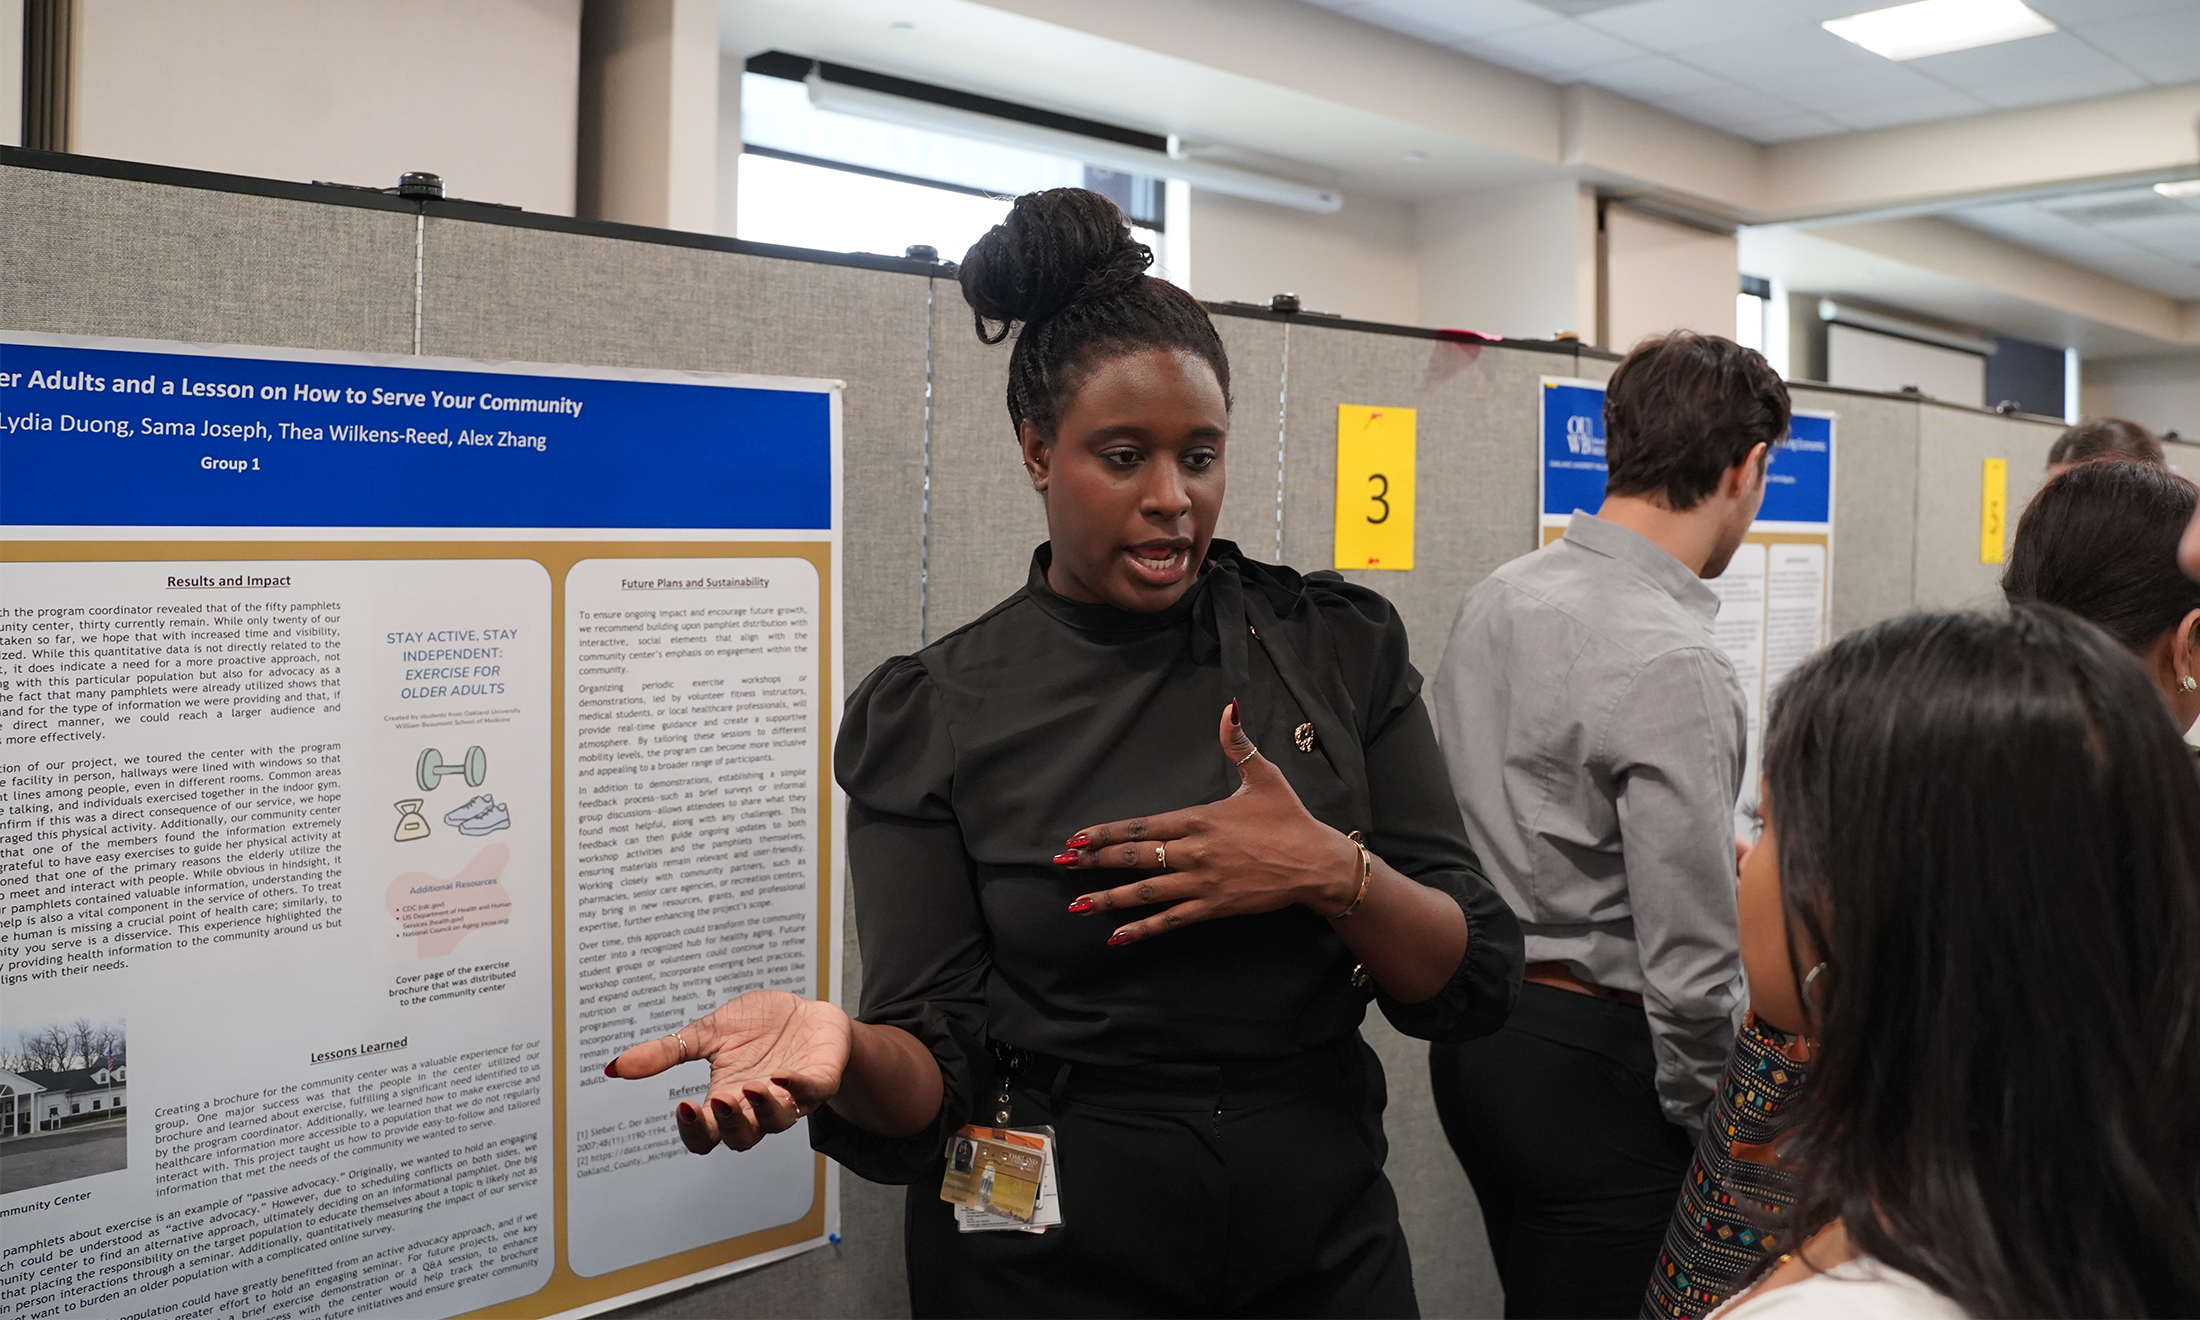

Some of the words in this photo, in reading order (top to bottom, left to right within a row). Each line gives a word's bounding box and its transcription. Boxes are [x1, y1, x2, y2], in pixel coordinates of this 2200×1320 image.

[0, 372, 22, 387] er
[27, 371, 105, 392] Adults
[112, 377, 155, 394] and
[161, 380, 174, 395] a
[181, 379, 254, 399] Lesson
[260, 385, 287, 400] on
[293, 385, 341, 403] How
[345, 387, 367, 404] to
[371, 389, 426, 407] Serve
[432, 391, 475, 409] Your
[479, 393, 583, 418] Community
[0, 412, 52, 434] Lydia
[60, 414, 134, 438] Duong,
[141, 417, 195, 436] Sama
[200, 419, 272, 442] Joseph,
[278, 422, 323, 440] Thea
[329, 424, 453, 448] Wilkens-Reed,
[457, 429, 493, 446] Alex
[497, 430, 546, 452] Zhang
[200, 456, 248, 473] Group
[251, 457, 260, 470] 1
[1366, 473, 1390, 525] 3
[167, 575, 215, 589] Results
[218, 574, 243, 589] and
[247, 575, 291, 588] Impact
[621, 578, 654, 589] Future
[657, 578, 683, 589] Plans
[685, 577, 704, 589] and
[706, 577, 769, 588] Sustainability
[14, 607, 34, 617] the
[37, 607, 85, 619] program
[88, 604, 153, 616] coordinator
[156, 603, 202, 614] revealed
[206, 603, 227, 613] that
[230, 602, 242, 612] of
[245, 602, 262, 612] the
[265, 601, 287, 613] fifty
[290, 601, 341, 613] pamphlets
[579, 610, 591, 620] To
[593, 611, 622, 620] ensure
[624, 610, 657, 620] ongoing
[659, 609, 687, 618] impact
[690, 608, 705, 617] and
[707, 608, 747, 617] encourage
[749, 606, 774, 615] future
[777, 606, 807, 616] growth,
[37, 636, 50, 645] so
[55, 633, 75, 645] far,
[80, 635, 97, 643] we
[102, 632, 130, 644] hope
[134, 632, 157, 642] that
[162, 630, 186, 640] with
[190, 629, 240, 640] increased
[244, 628, 269, 638] time
[272, 627, 291, 637] and
[295, 626, 340, 637] visibility,
[386, 631, 423, 644] STAY
[426, 629, 479, 642] ACTIVE,
[483, 628, 518, 641] STAY
[403, 647, 502, 662] INDEPENDENT:
[405, 666, 470, 681] EXERCISE
[473, 665, 501, 677] FOR
[400, 685, 447, 699] OLDER
[450, 682, 505, 696] ADULTS
[383, 714, 410, 722] Created
[421, 720, 453, 728] Beaumont
[27, 760, 40, 772] of
[45, 761, 65, 770] our
[71, 757, 117, 770] project,
[123, 756, 140, 764] we
[146, 751, 182, 763] toured
[187, 750, 205, 760] the
[210, 749, 244, 762] center
[250, 745, 273, 755] with
[278, 744, 295, 754] the
[300, 742, 341, 754] program
[409, 882, 454, 895] Additional
[455, 878, 497, 889] Resources
[401, 904, 417, 913] CDC
[417, 901, 445, 911] (cdc.gov)
[402, 913, 412, 921] US
[412, 909, 449, 920] Department
[457, 905, 477, 913] Health
[490, 901, 512, 909] Human
[402, 921, 428, 930] Services
[428, 915, 464, 926] (health.gov)
[395, 974, 421, 985] Cover
[423, 971, 444, 982] page
[446, 967, 455, 977] of
[457, 966, 472, 975] the
[474, 961, 510, 972] exercise
[388, 984, 429, 997] brochure
[431, 980, 449, 990] that
[451, 978, 468, 986] was
[469, 969, 516, 984] distributed
[399, 999, 409, 1007] to
[411, 996, 427, 1005] the
[428, 988, 476, 1002] community
[478, 983, 506, 994] center
[311, 1047, 357, 1065] Lessons
[360, 1036, 407, 1055] Learned
[154, 1102, 200, 1118] Creating
[203, 1100, 210, 1109] a
[213, 1091, 259, 1107] brochure
[262, 1088, 278, 1097] for
[281, 1084, 298, 1094] the
[300, 1074, 354, 1091] community
[356, 1068, 388, 1080] center
[390, 1064, 409, 1073] was
[419, 1054, 457, 1068] valuable
[459, 1046, 508, 1061] experience
[511, 1043, 523, 1051] for
[526, 1040, 540, 1049] our
[3, 1236, 65, 1259] pamphlets
[68, 1226, 102, 1242] about
[105, 1216, 152, 1233] exercise
[155, 1213, 164, 1222] is
[167, 1210, 180, 1220] an
[184, 1198, 229, 1216] example
[232, 1194, 243, 1205] of
[246, 1186, 288, 1203] “passive
[291, 1172, 345, 1192] advocacy.”
[348, 1162, 396, 1179] Originally,
[400, 1159, 414, 1167] we
[416, 1149, 449, 1164] wanted
[452, 1148, 462, 1156] to
[464, 1142, 484, 1153] hold
[486, 1141, 497, 1149] an
[499, 1132, 537, 1146] engaging
[53, 1191, 92, 1206] Center
